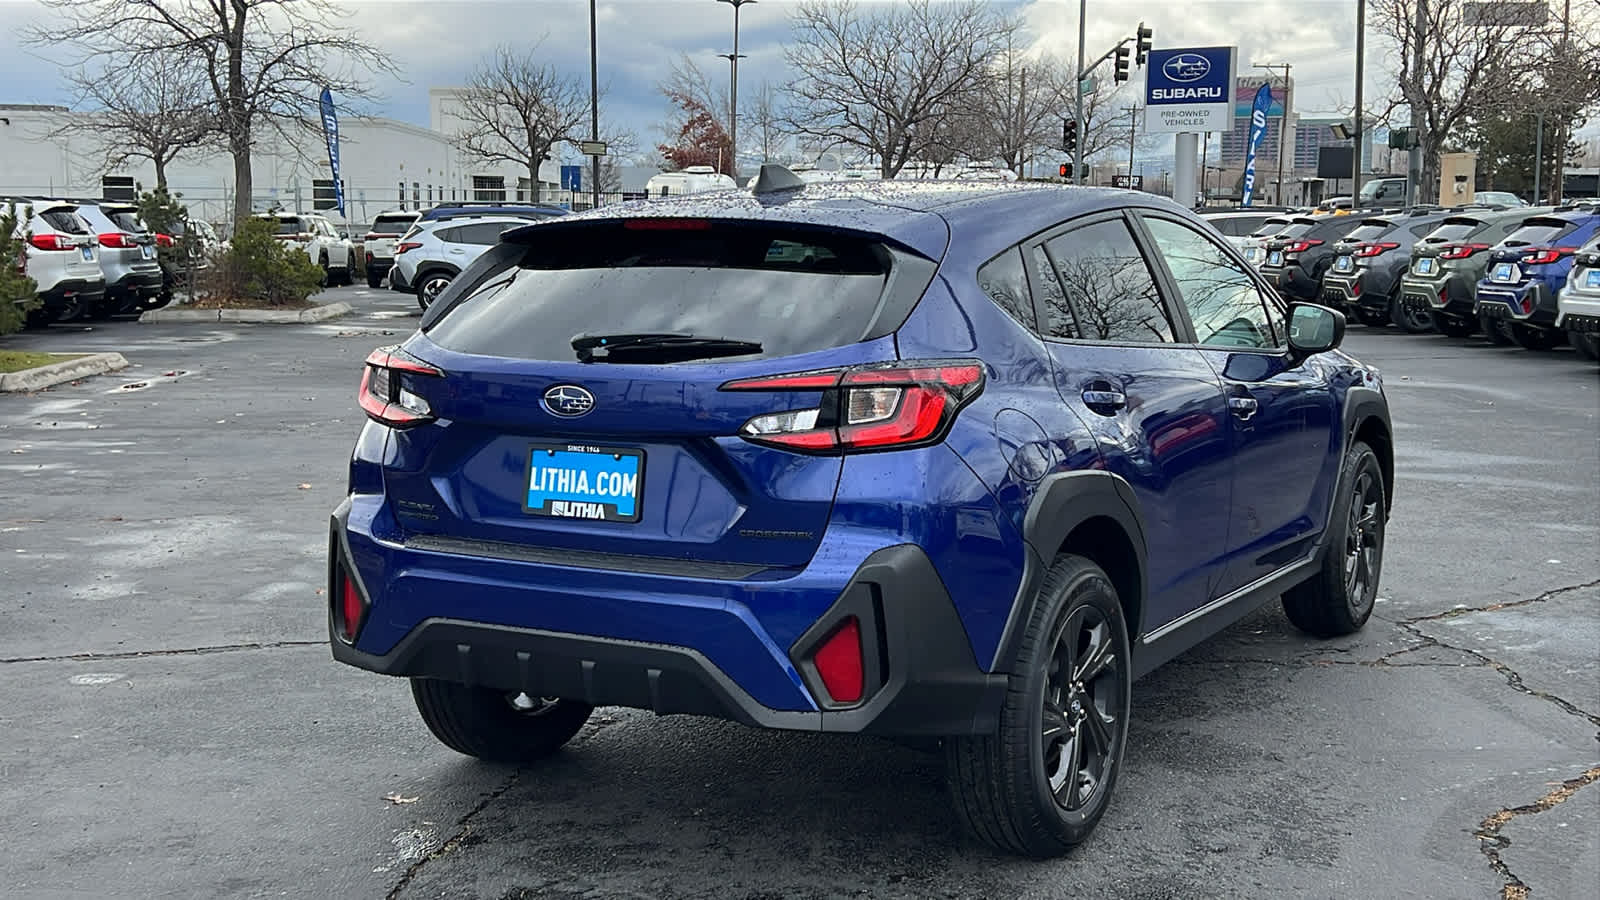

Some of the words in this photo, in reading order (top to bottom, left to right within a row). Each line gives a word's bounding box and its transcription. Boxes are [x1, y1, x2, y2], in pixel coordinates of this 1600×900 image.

[1152, 87, 1221, 99] SUBARU
[1165, 118, 1205, 126] VEHICLES
[529, 466, 638, 498] LITHIA.COM
[564, 502, 605, 519] LITHIA
